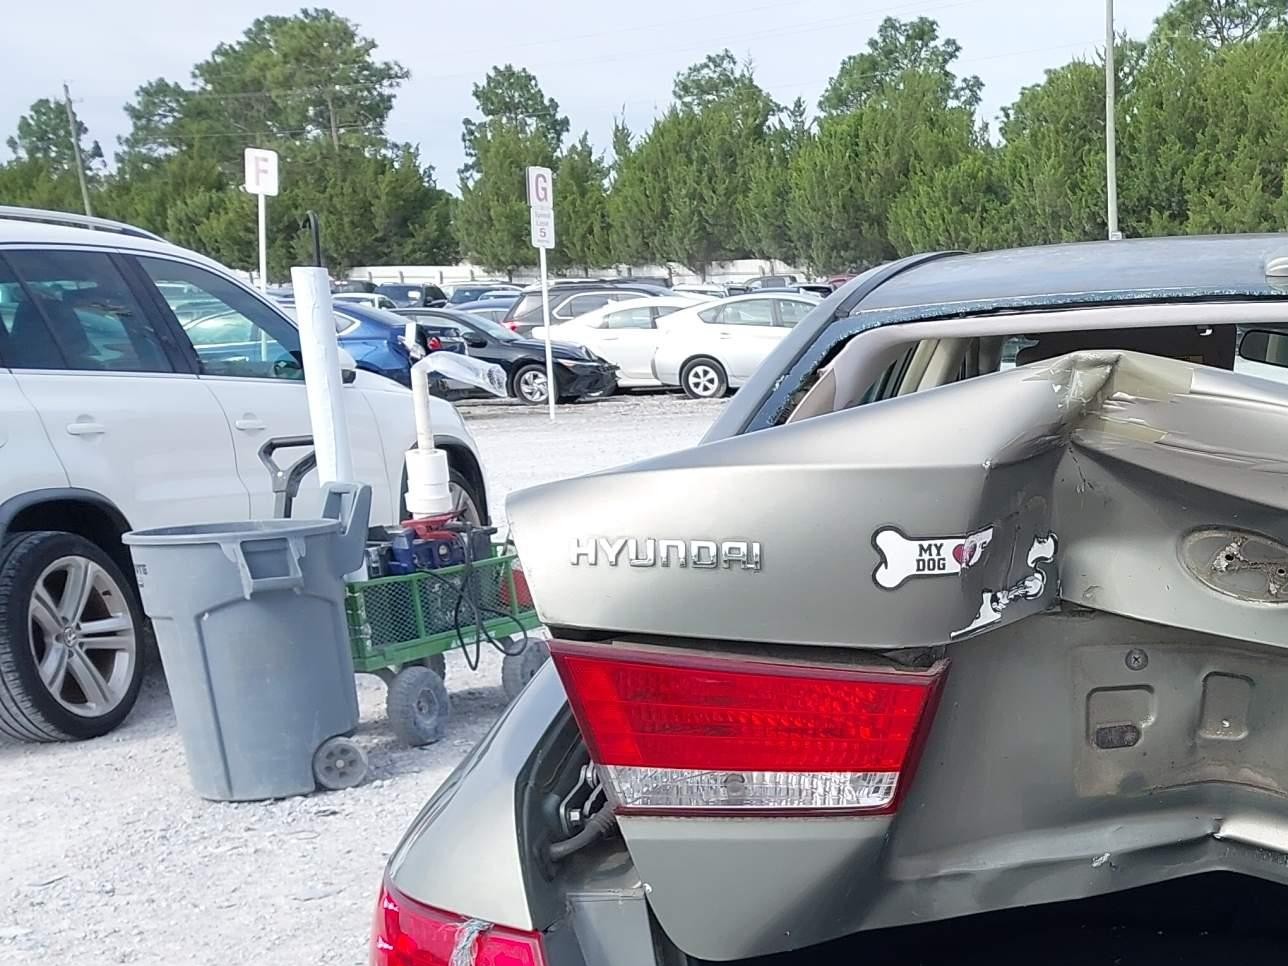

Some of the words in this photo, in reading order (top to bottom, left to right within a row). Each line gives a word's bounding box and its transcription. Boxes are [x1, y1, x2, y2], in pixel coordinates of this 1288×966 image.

[254, 155, 269, 187] F
[535, 173, 548, 202] G
[539, 227, 546, 238] 5
[570, 538, 761, 570] HYUNDAI
[918, 543, 945, 558] MY
[915, 558, 946, 572] DOG
